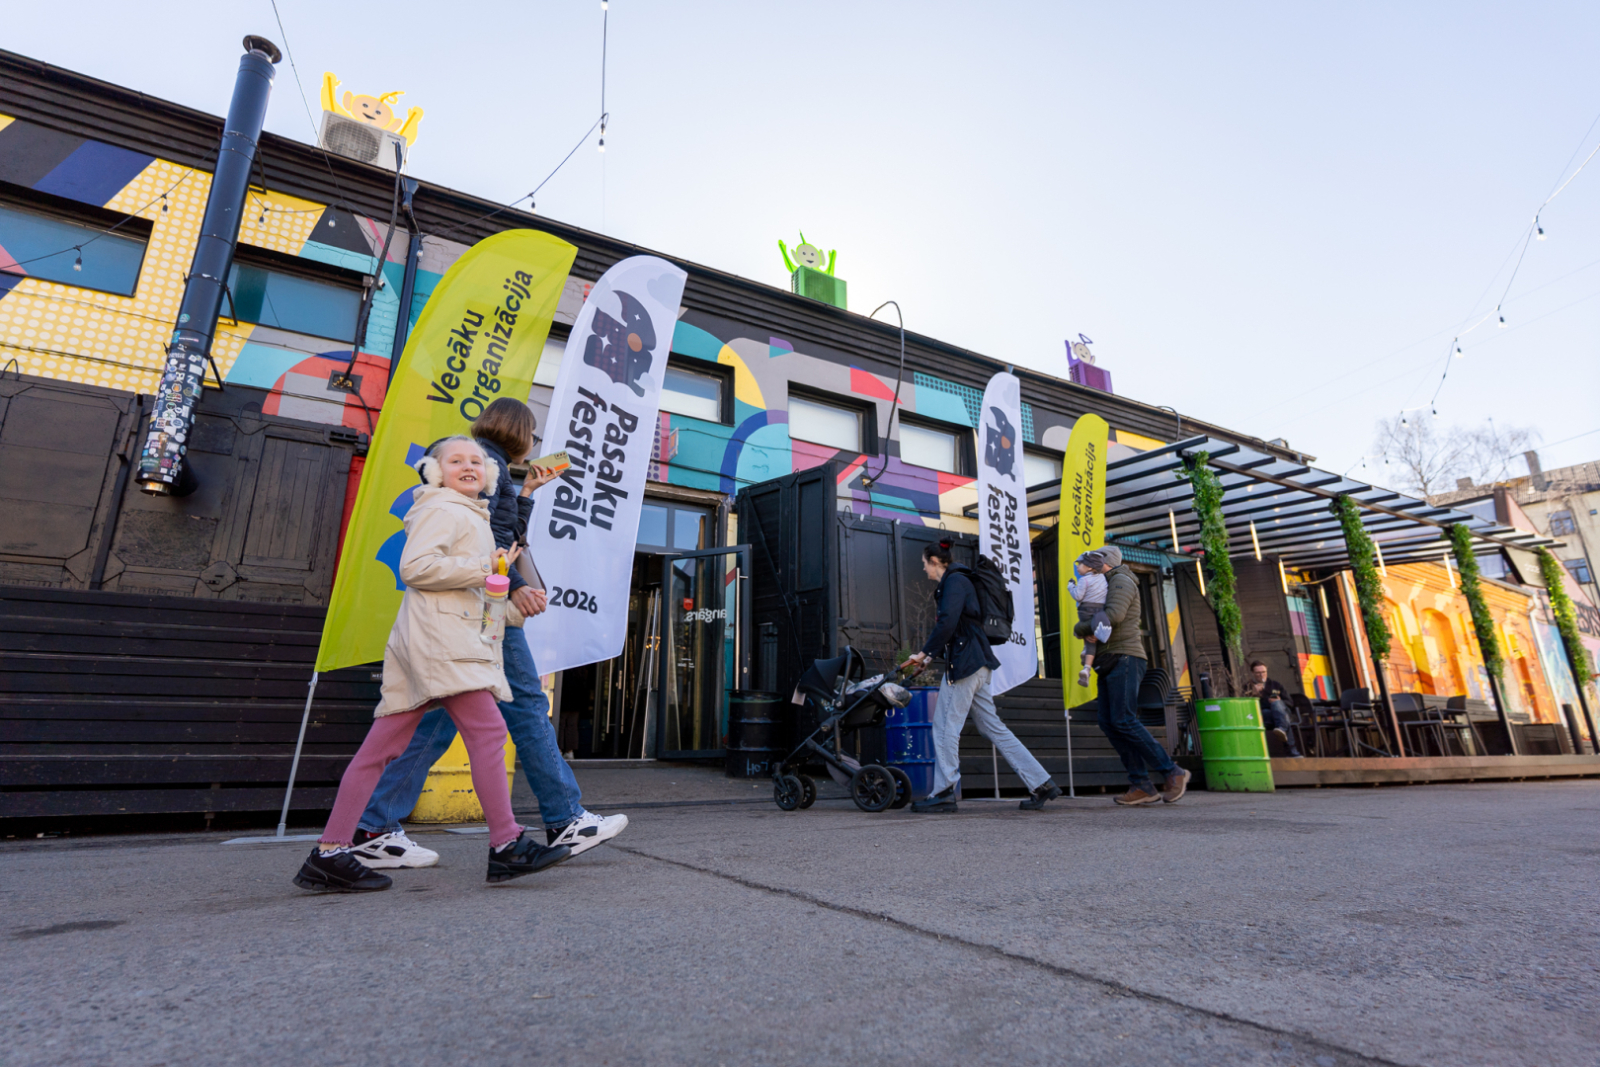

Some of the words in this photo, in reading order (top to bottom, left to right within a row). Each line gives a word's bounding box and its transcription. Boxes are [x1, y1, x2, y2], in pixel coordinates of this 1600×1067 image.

[426, 309, 484, 405] Vecāku
[460, 270, 533, 422] Organizācija
[549, 386, 607, 541] festivāls
[589, 403, 639, 531] Pasaku
[1071, 472, 1083, 537] Vecāku
[1081, 442, 1095, 547] Organizācija
[1004, 491, 1022, 585] Pasaku
[549, 586, 598, 615] 2026
[1006, 631, 1027, 646] 026
